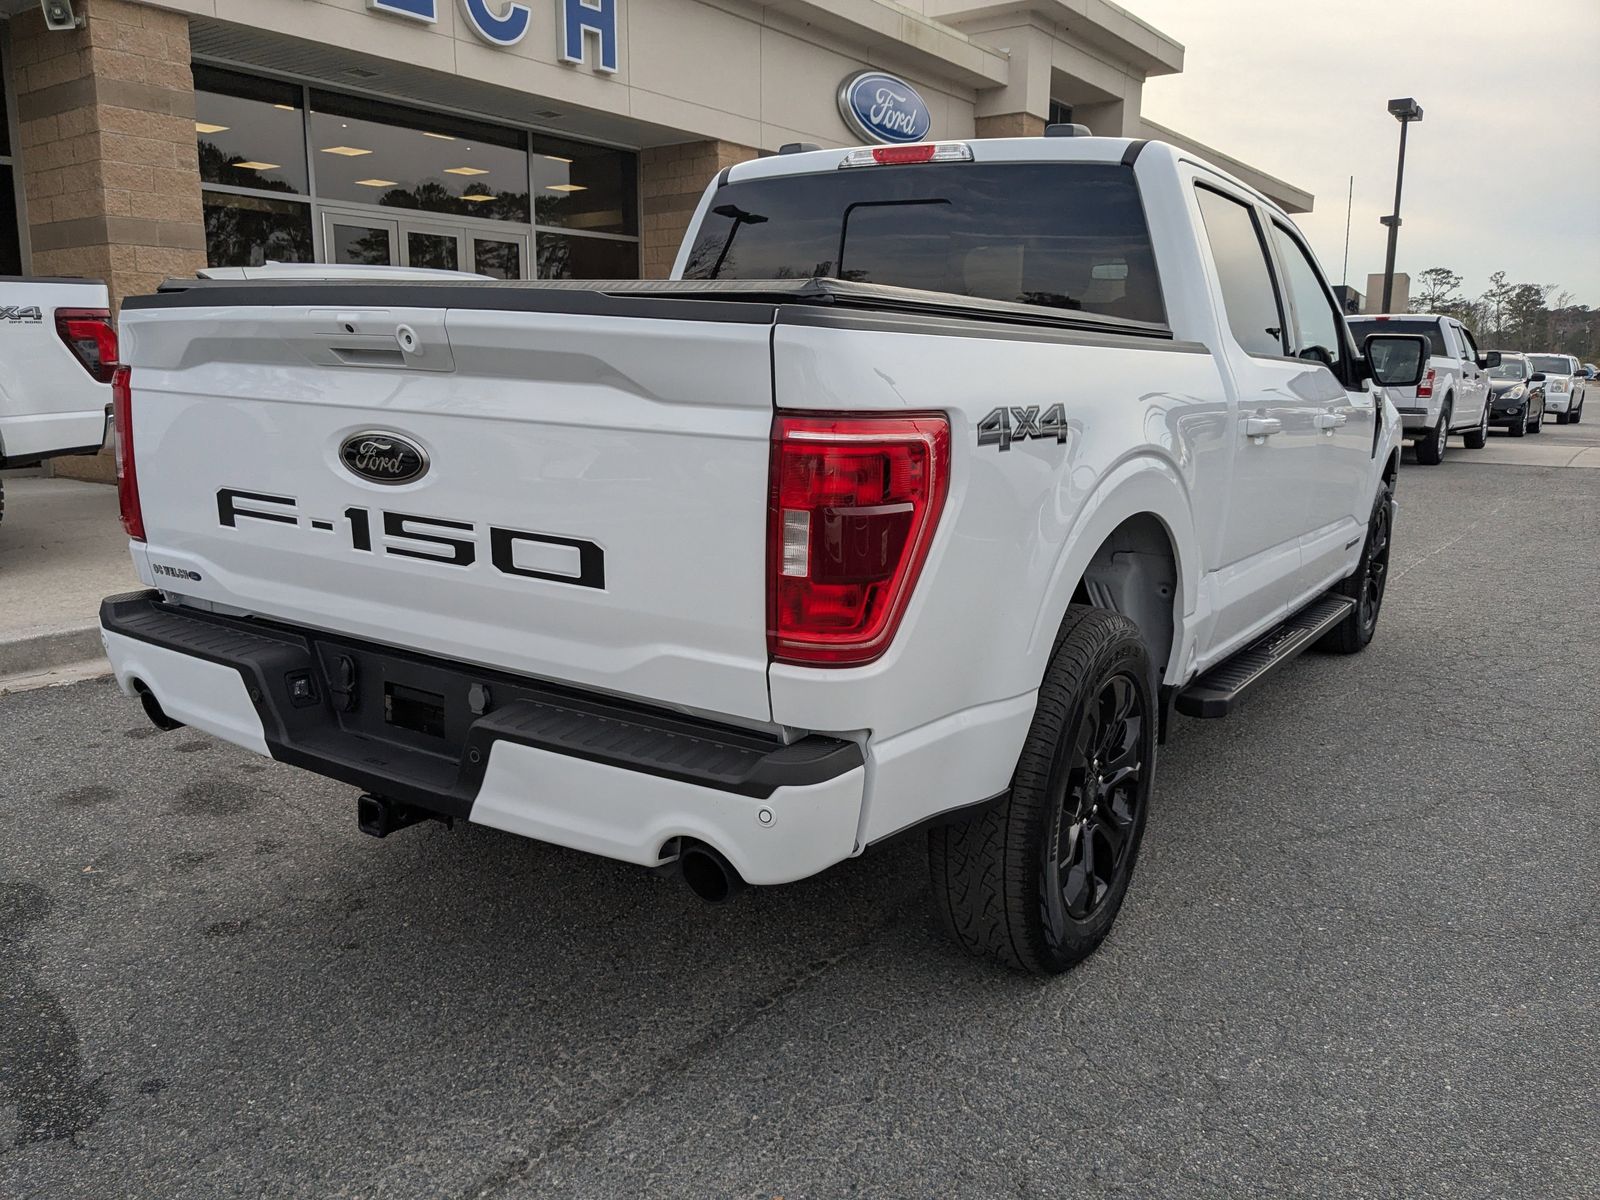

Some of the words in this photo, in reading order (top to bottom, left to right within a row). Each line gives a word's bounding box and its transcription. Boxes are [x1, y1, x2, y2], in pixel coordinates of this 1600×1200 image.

[870, 87, 917, 135] Ford
[355, 441, 404, 474] Ford
[216, 488, 606, 590] F-150
